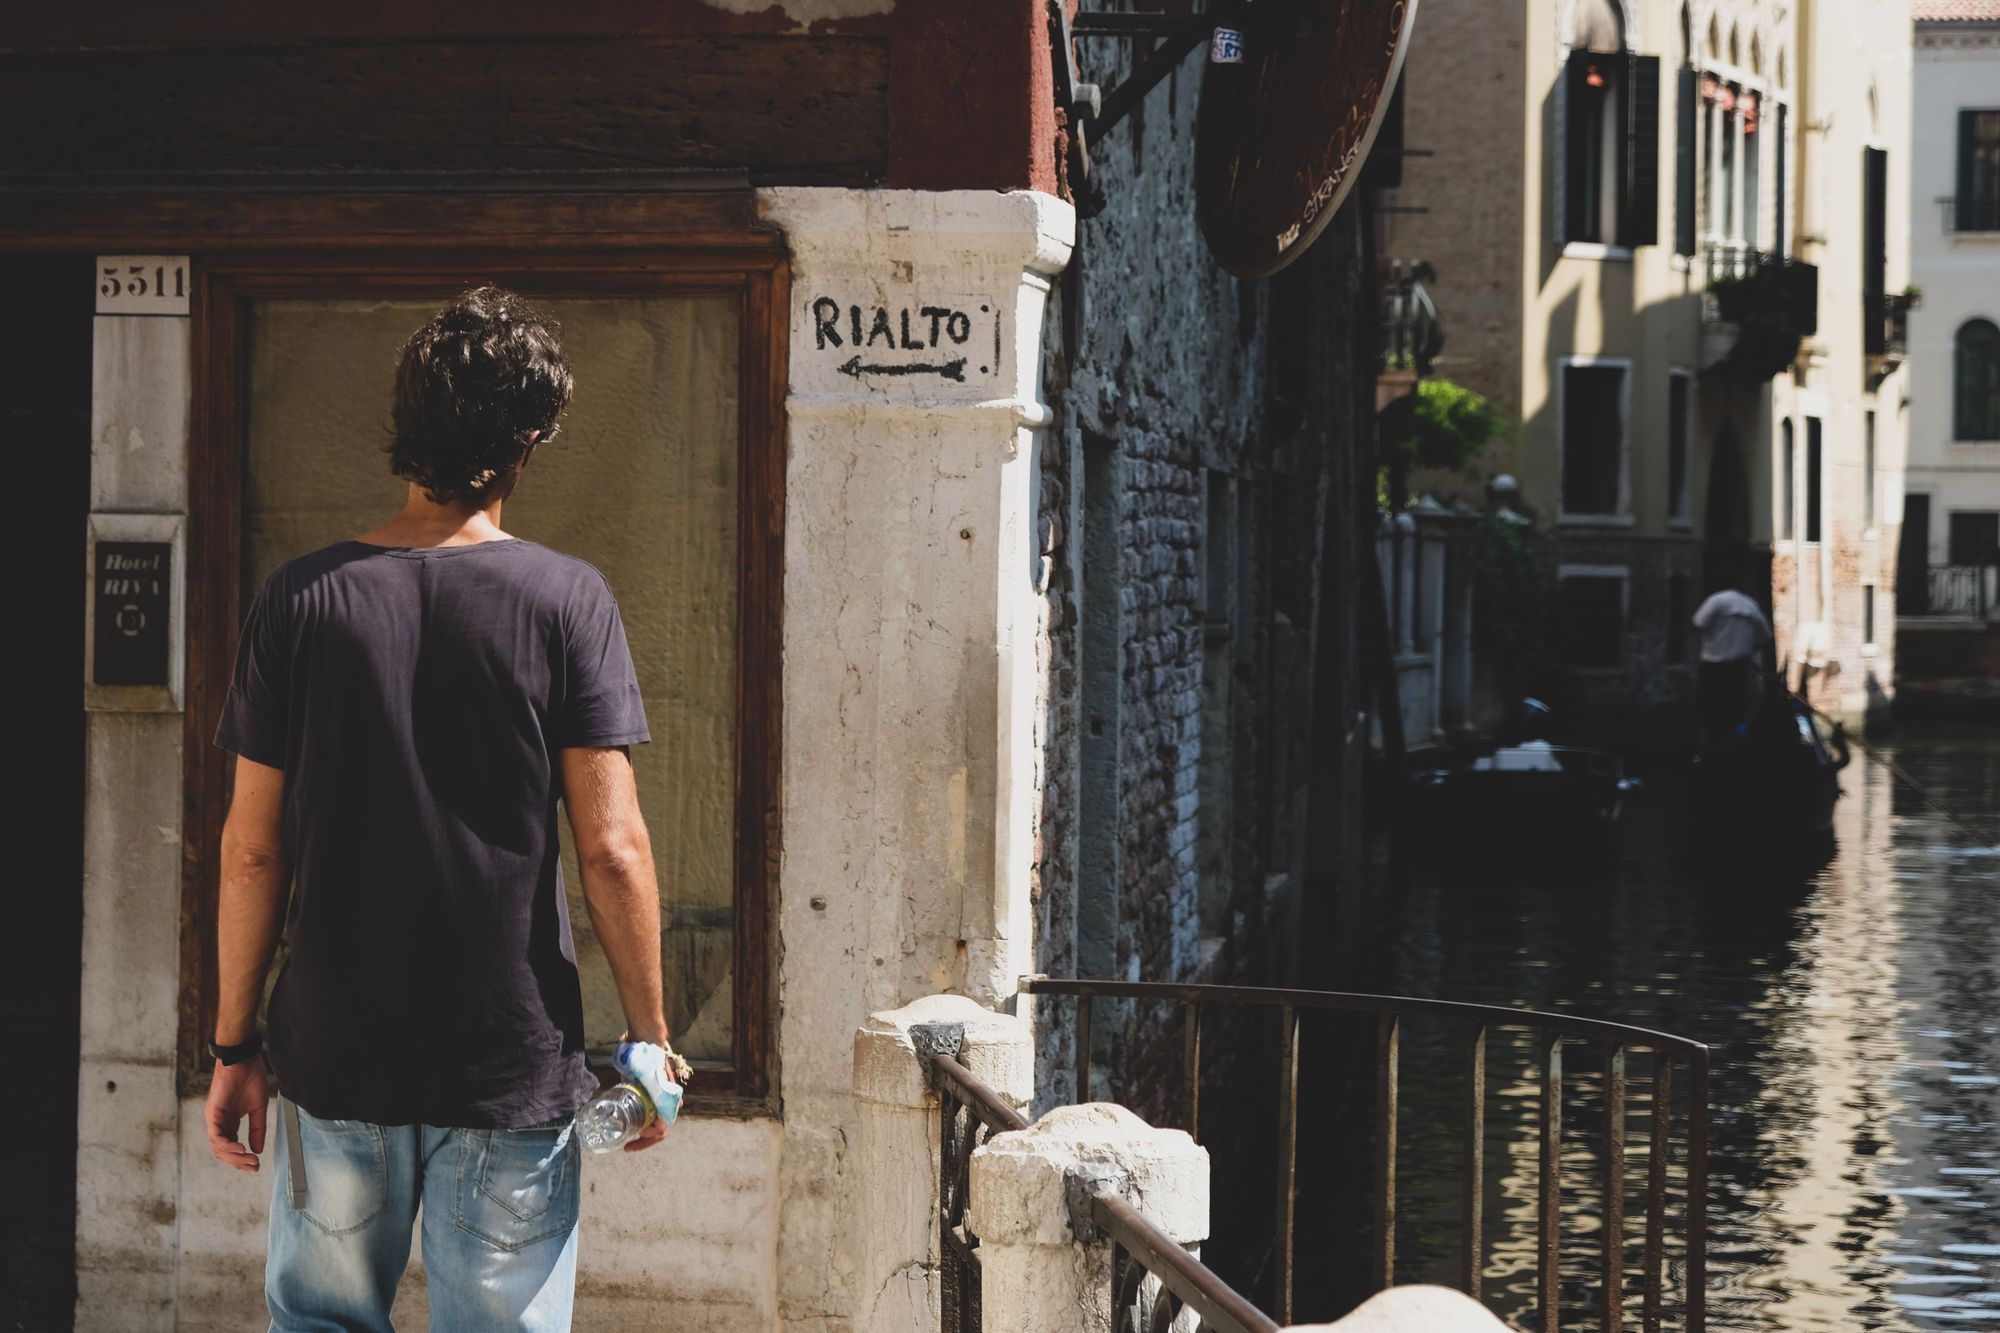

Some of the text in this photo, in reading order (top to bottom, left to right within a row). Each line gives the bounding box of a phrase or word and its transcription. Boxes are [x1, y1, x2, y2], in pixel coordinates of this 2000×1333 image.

[100, 265, 185, 298] 5311
[813, 296, 971, 350] RIALTO
[104, 553, 161, 571] Hotel
